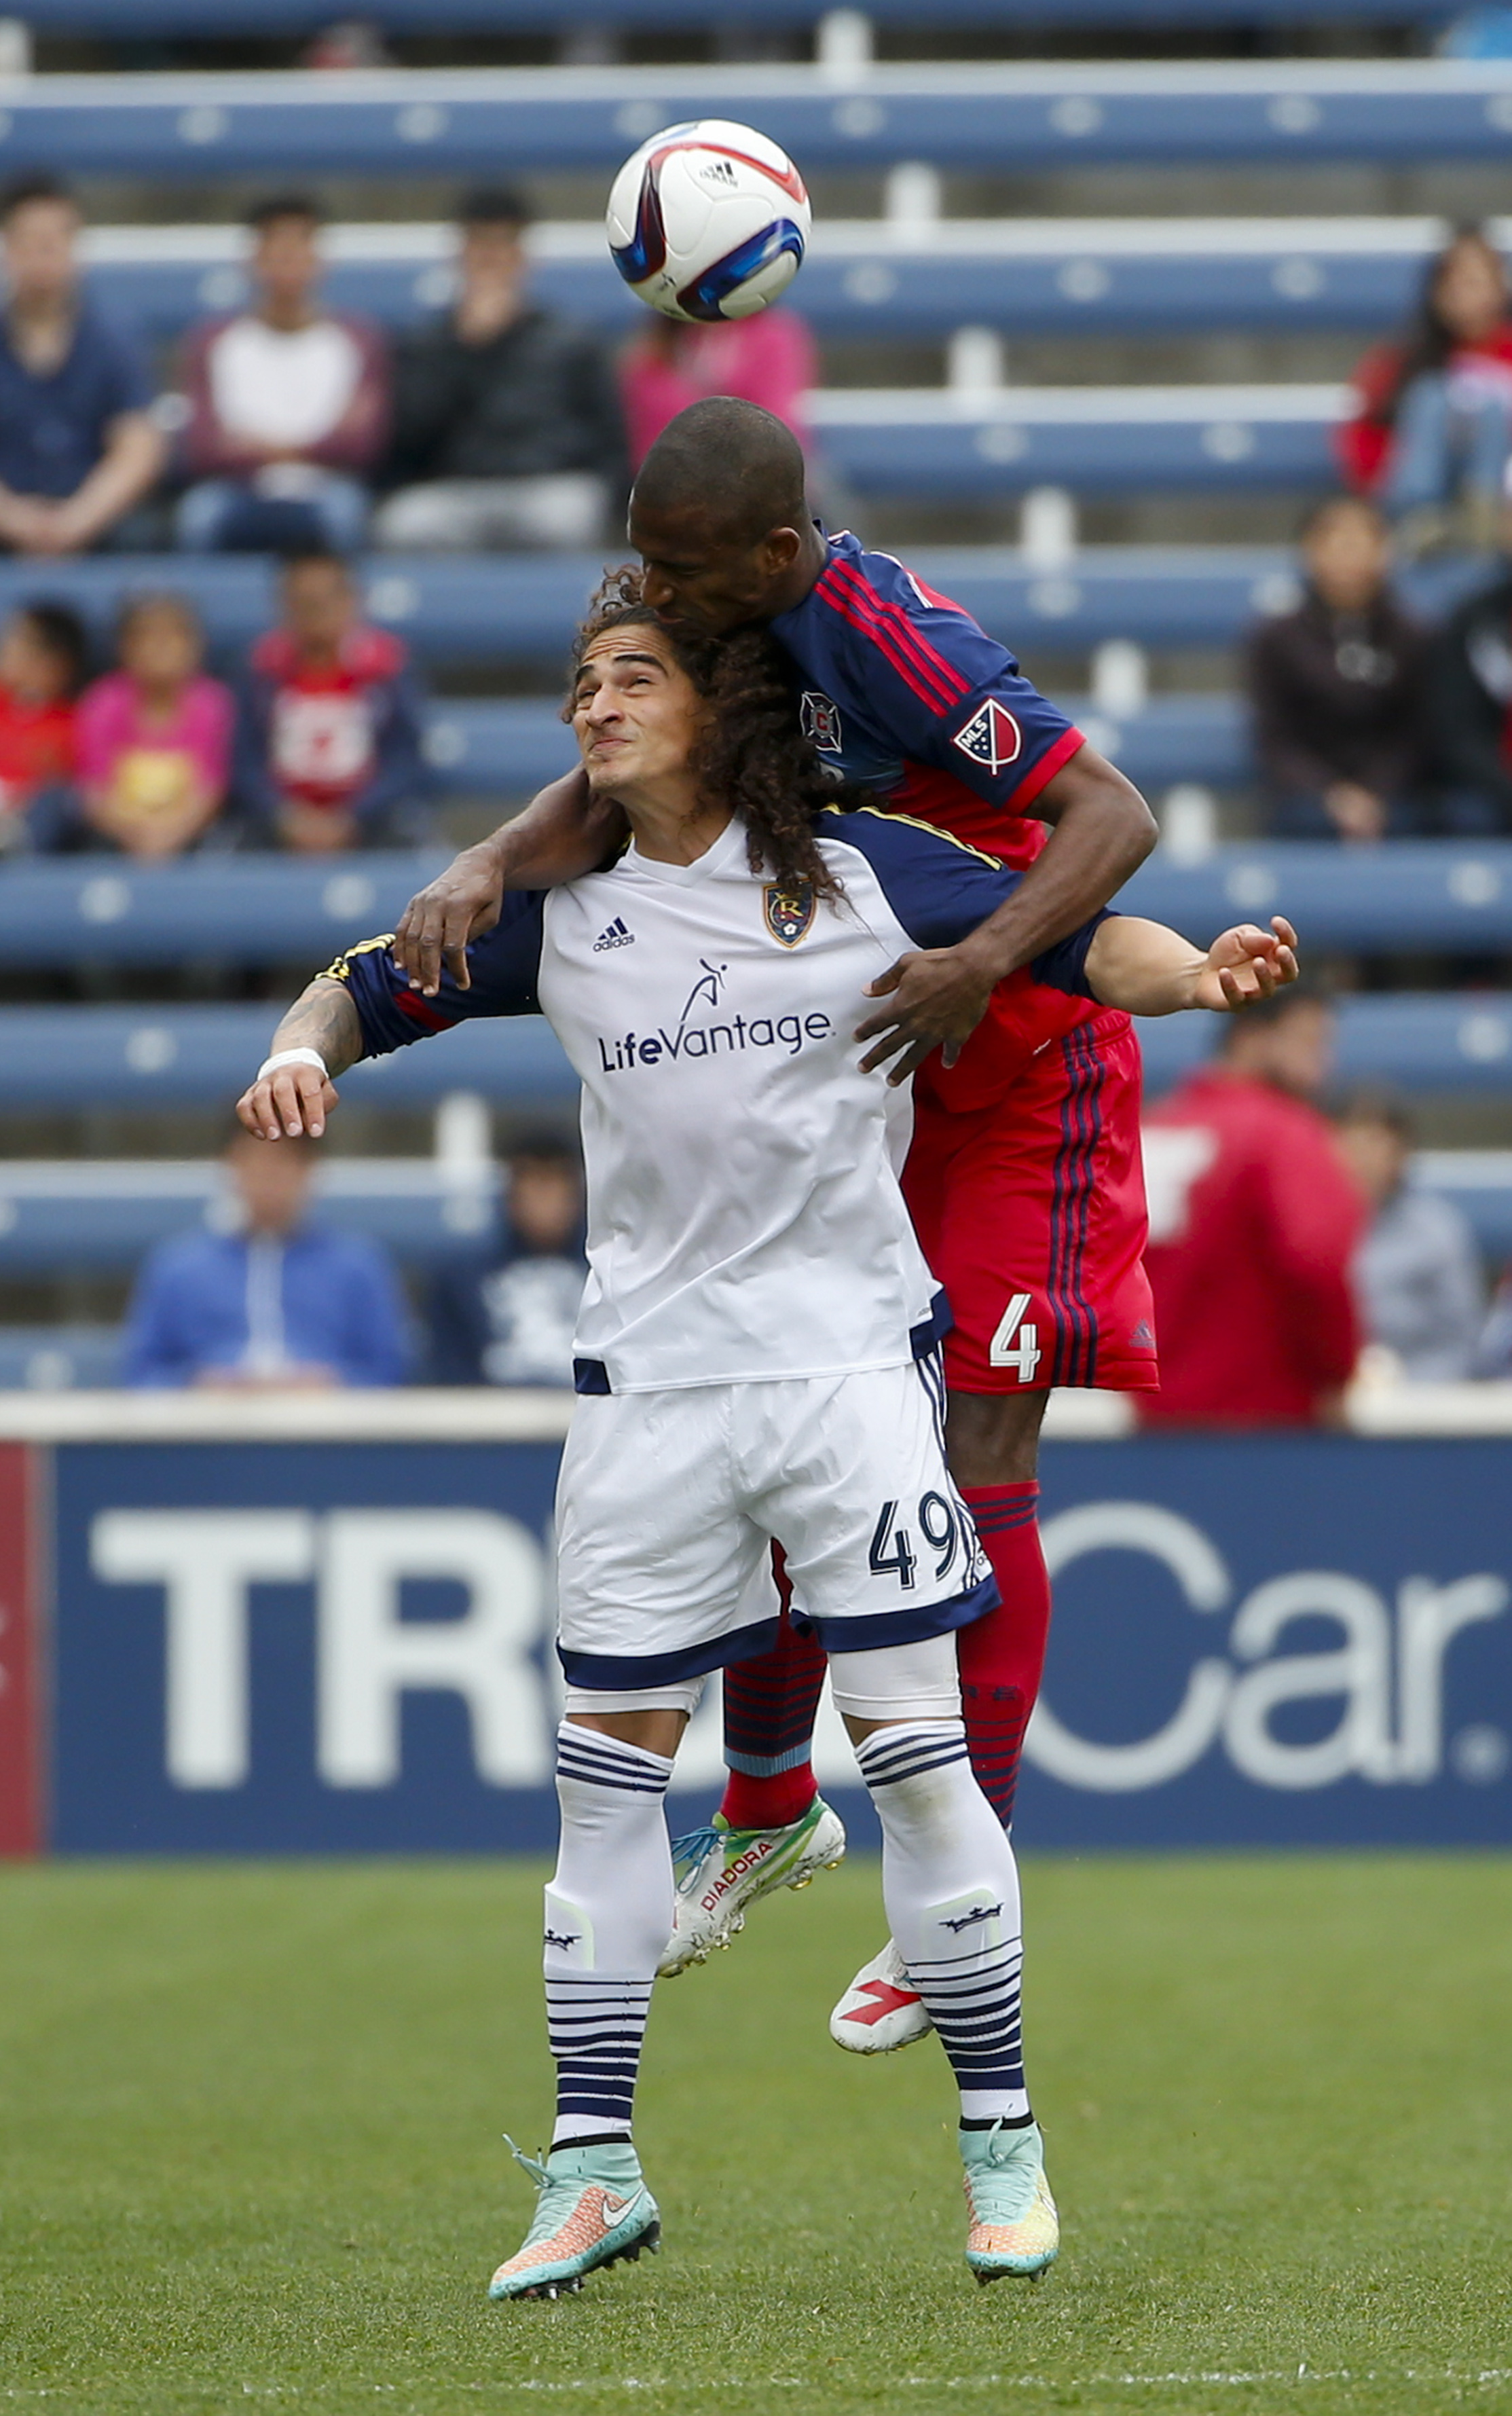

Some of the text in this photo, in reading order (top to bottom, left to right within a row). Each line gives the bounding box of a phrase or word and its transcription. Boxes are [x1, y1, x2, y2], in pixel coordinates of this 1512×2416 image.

[961, 719, 988, 748] MLS
[593, 934, 635, 952] adidas
[598, 1013, 832, 1073] LifeVantage
[990, 1293, 1041, 1383] 4
[869, 1490, 958, 1590] 49
[701, 1841, 773, 1911] DIADORA
